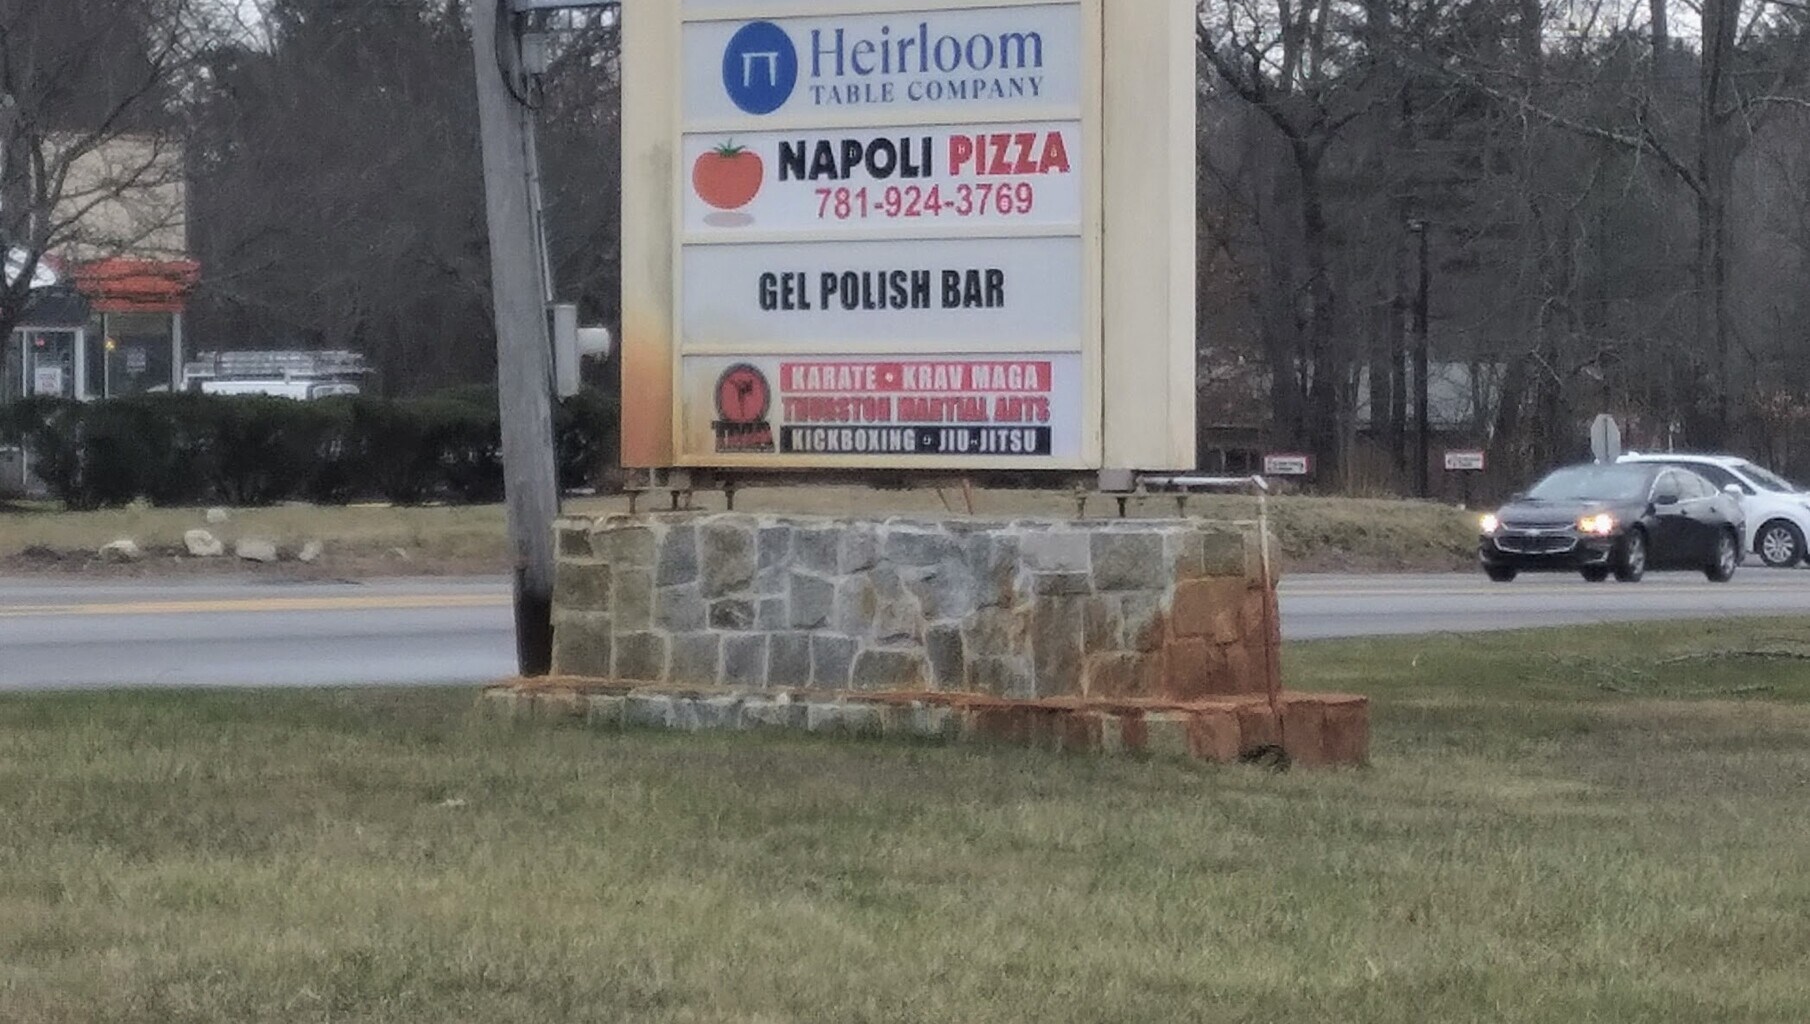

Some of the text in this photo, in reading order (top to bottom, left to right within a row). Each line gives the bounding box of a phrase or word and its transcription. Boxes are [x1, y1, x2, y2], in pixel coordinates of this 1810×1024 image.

[810, 22, 1043, 78] Heirloom
[809, 76, 1044, 105] TABLE COMPANY
[777, 130, 1071, 182] NAPOLI PIZZA
[815, 181, 1034, 220] 781-924-3769
[758, 268, 1005, 311] GEL POLISH BAR
[791, 364, 1038, 390] KARATE KRAV MAGA
[897, 395, 989, 422] MARTIAL
[993, 394, 1051, 422] ARTS
[791, 428, 916, 452] KICKBOXING
[938, 428, 1037, 452] JIU-JITSU
